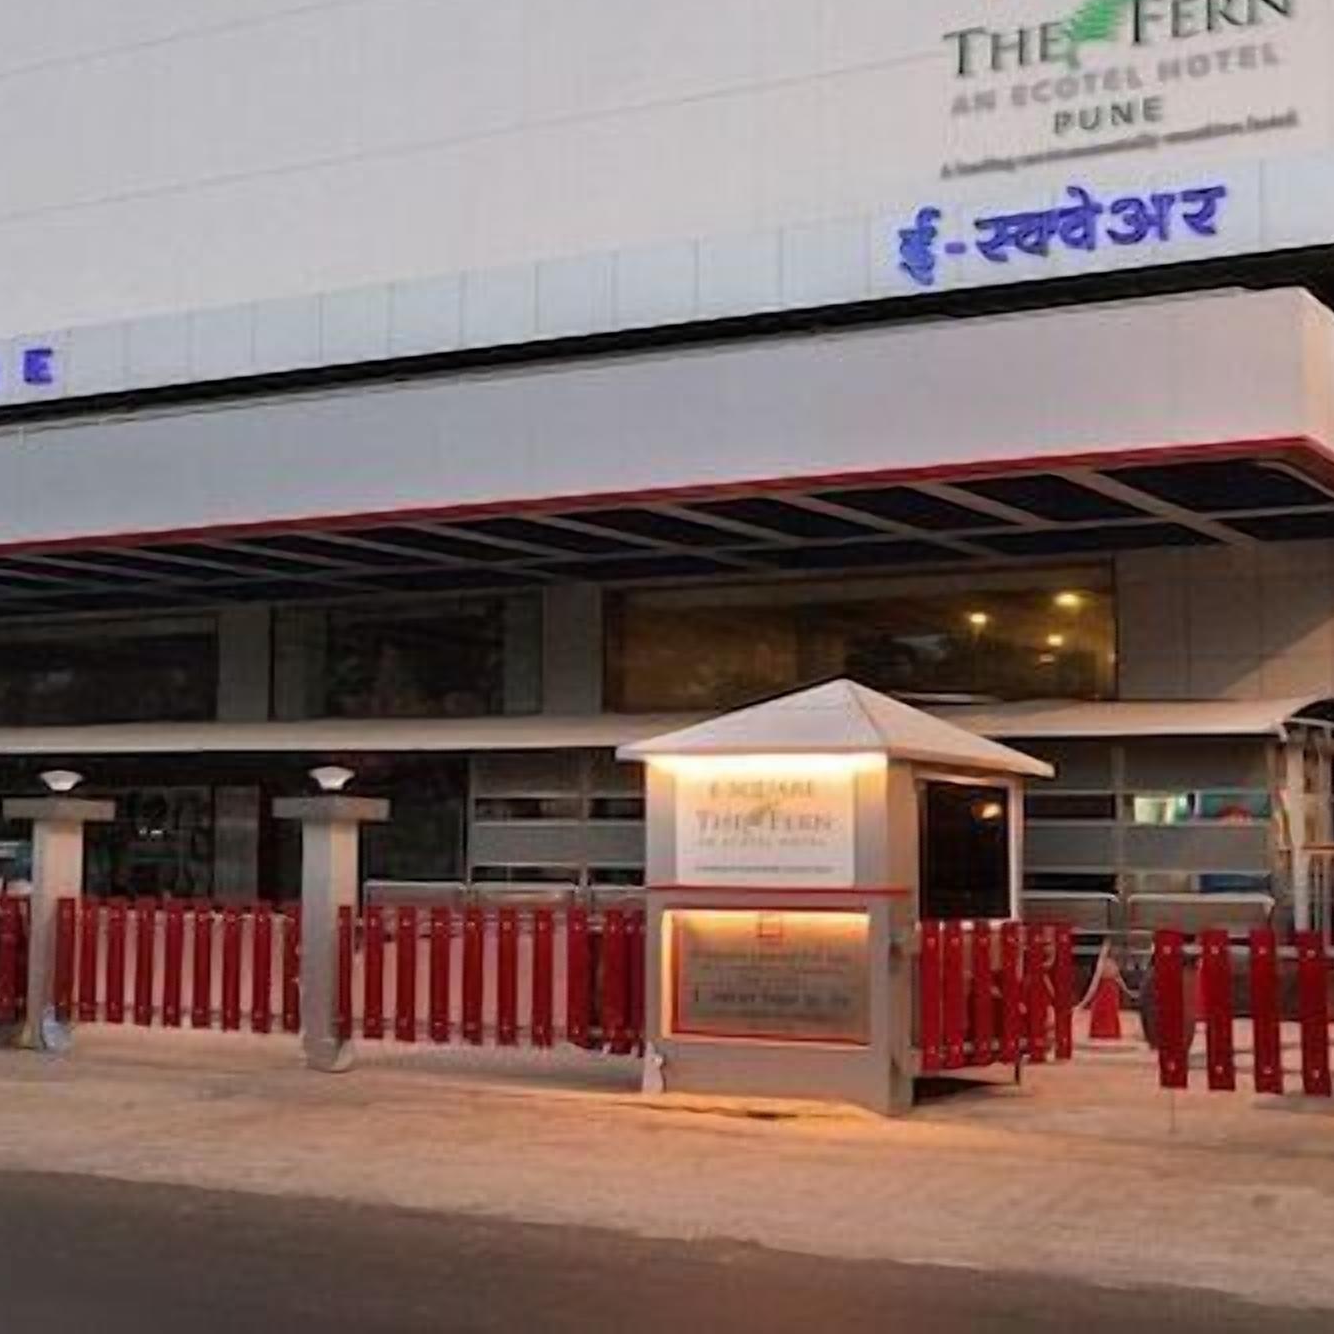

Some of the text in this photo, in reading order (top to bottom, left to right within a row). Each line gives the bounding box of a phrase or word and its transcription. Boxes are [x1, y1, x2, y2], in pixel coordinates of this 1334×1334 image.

[943, 22, 1067, 78] THE
[951, 42, 1280, 115] AN ECOTEL HOTEL
[1053, 96, 1164, 135] PUNE
